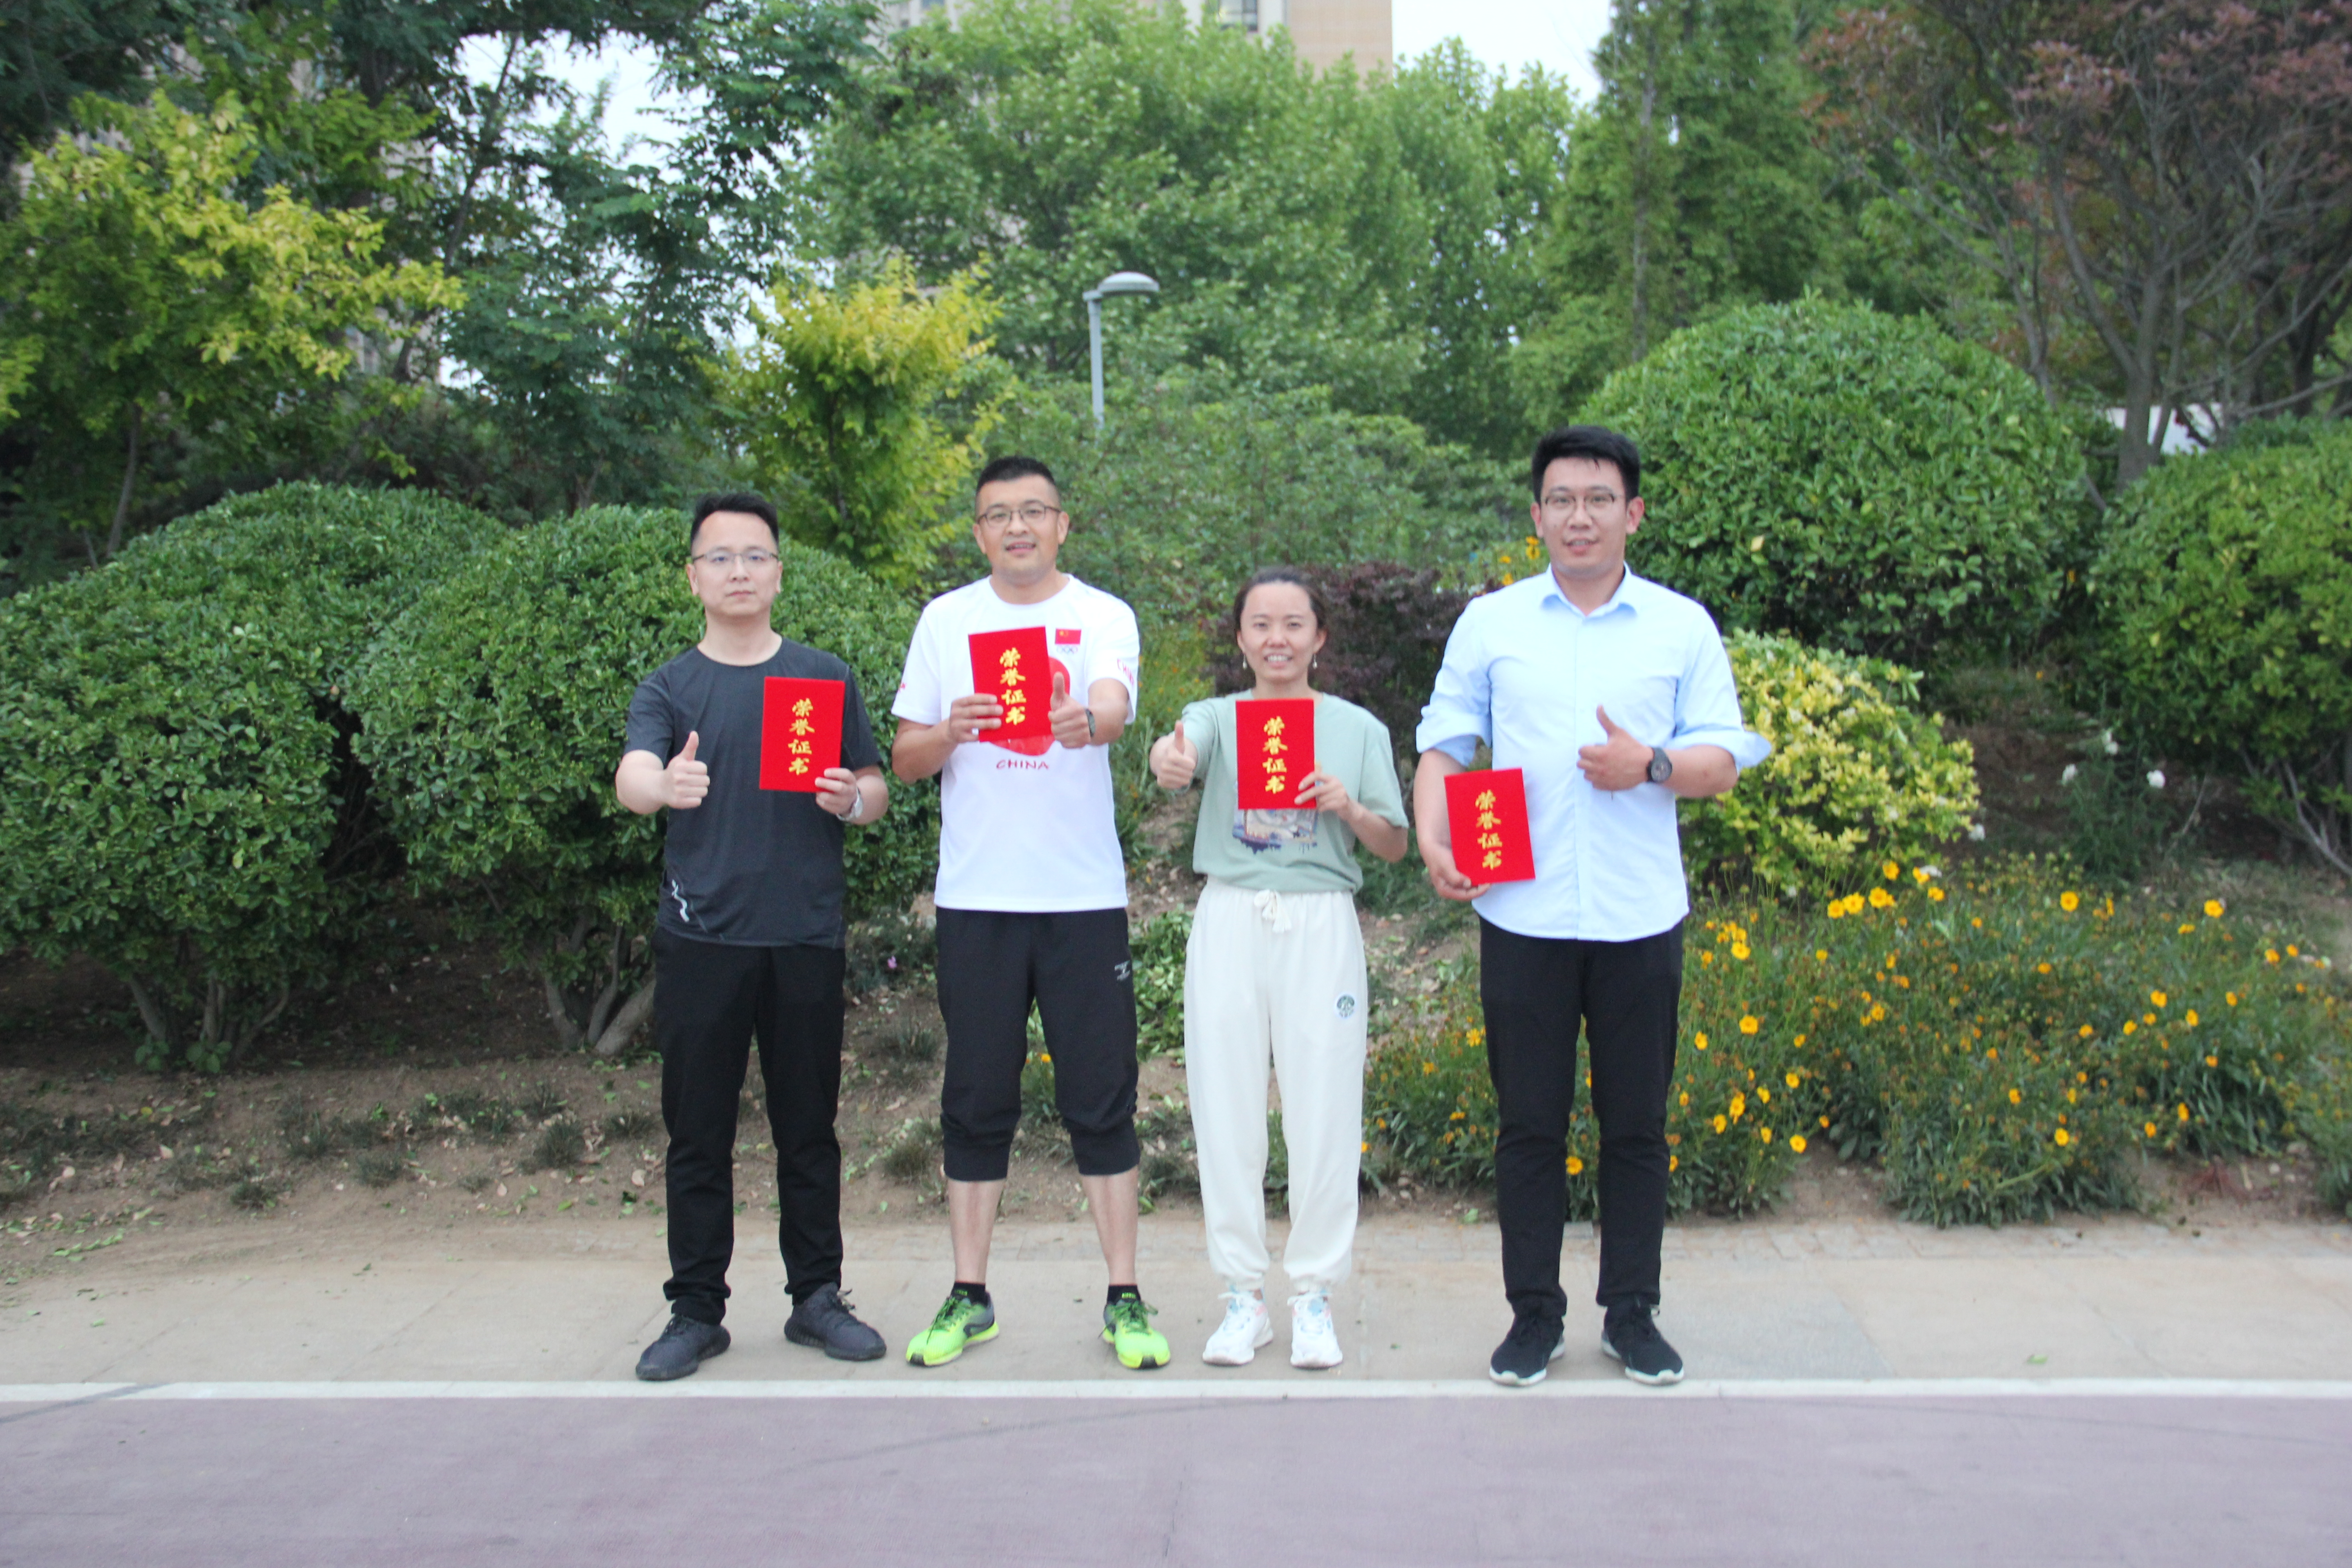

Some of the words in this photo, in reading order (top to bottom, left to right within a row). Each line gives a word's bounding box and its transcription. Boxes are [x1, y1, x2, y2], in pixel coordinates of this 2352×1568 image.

[999, 647, 1026, 725] 荣誉证书
[788, 698, 815, 775] 荣誉证书
[996, 759, 1049, 769] CHINA
[1262, 716, 1288, 794] 荣誉证书
[1475, 789, 1503, 870] 荣誉证书
